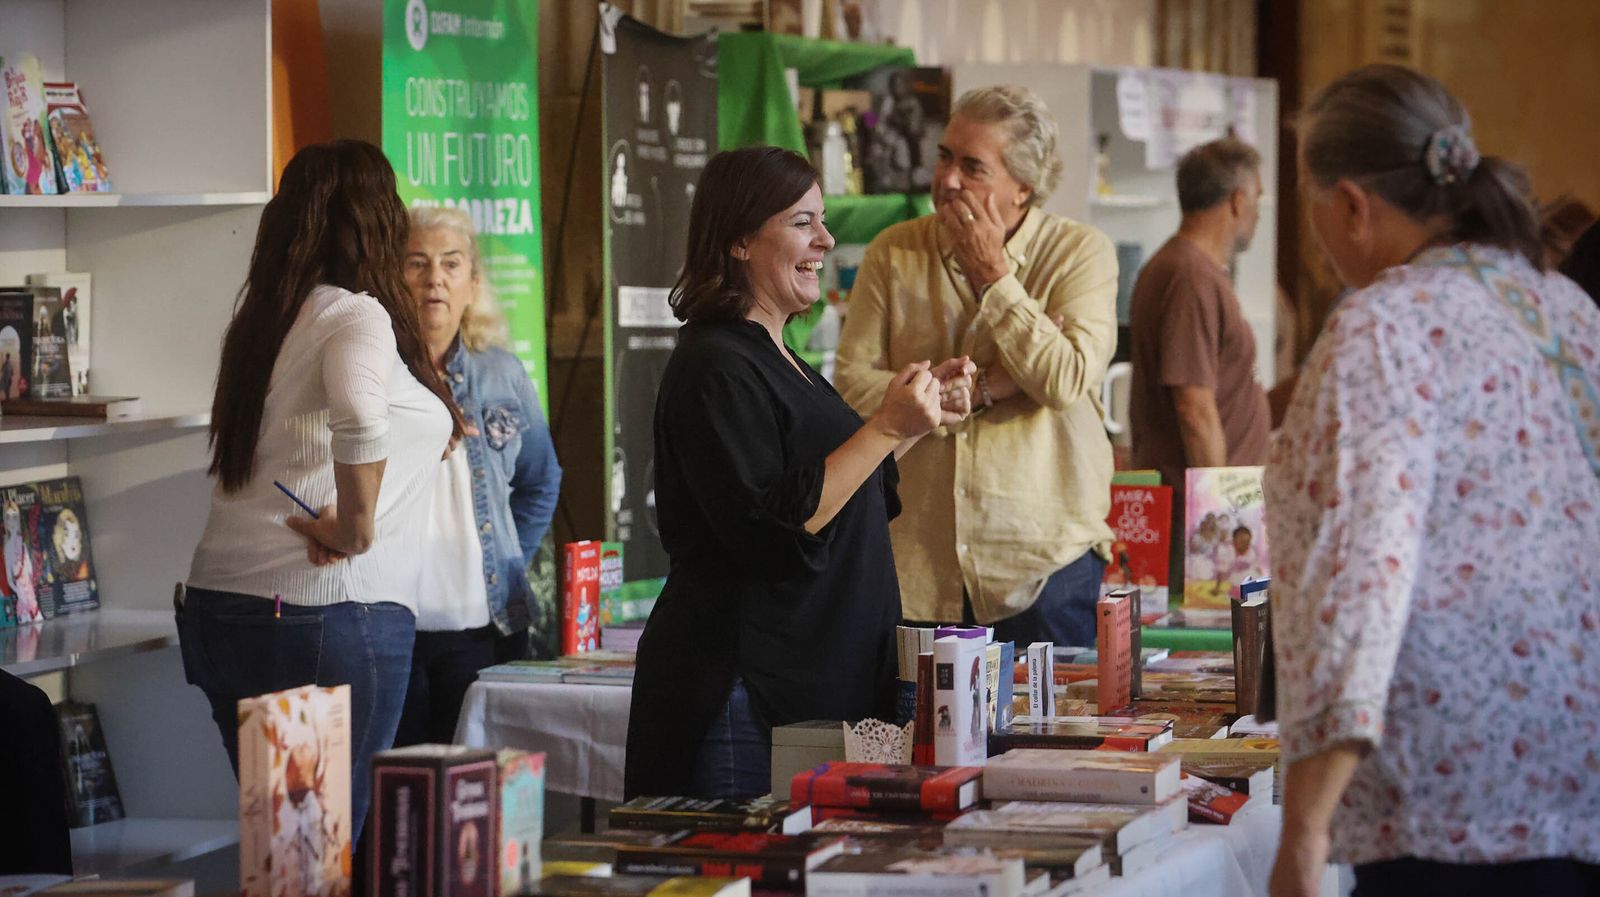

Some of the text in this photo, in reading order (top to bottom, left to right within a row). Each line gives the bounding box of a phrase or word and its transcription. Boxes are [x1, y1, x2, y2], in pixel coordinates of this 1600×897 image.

[405, 76, 529, 121] CONSTRUYAMOS
[406, 132, 533, 189] UN FUTURO
